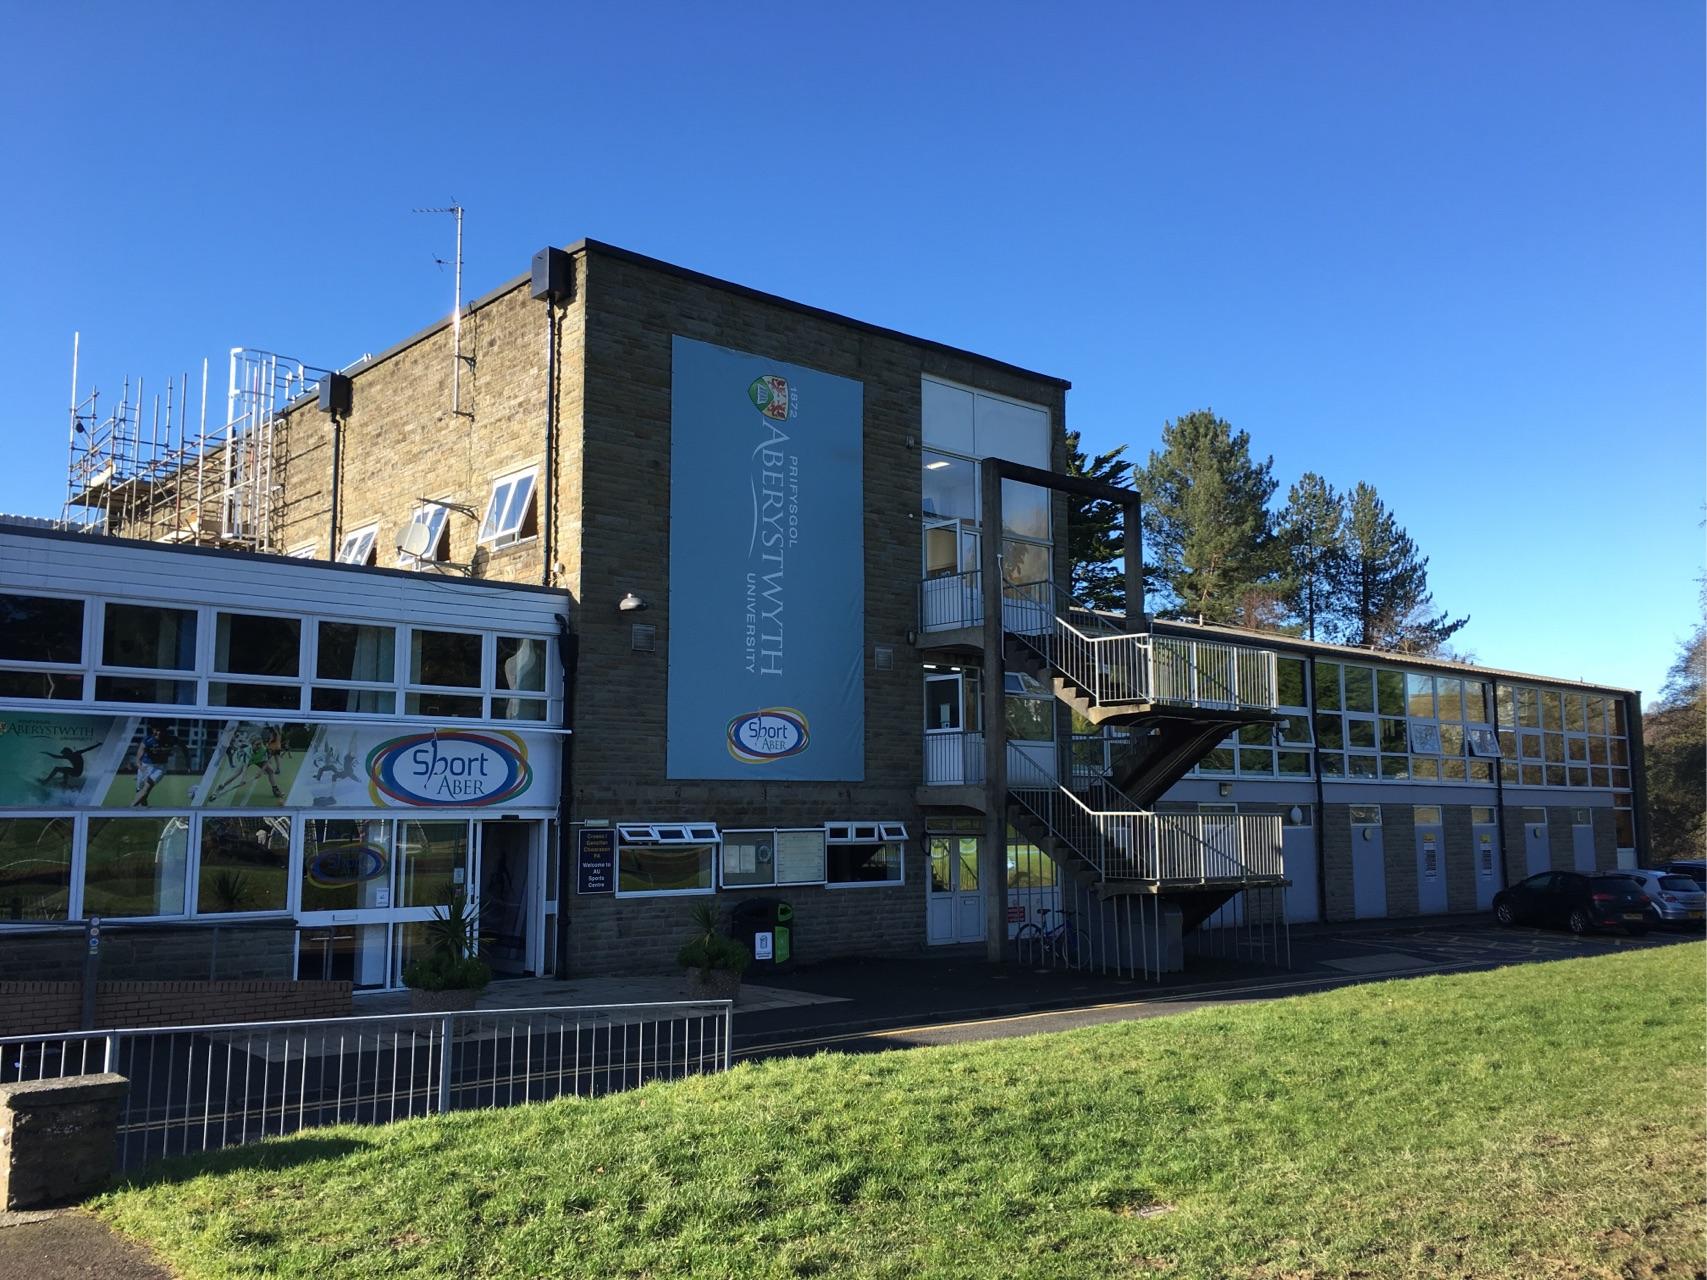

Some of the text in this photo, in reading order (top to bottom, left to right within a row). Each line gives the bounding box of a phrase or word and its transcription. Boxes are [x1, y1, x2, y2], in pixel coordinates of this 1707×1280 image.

[789, 386, 799, 419] 1872
[788, 455, 799, 548] PRIFYSGOL
[751, 416, 790, 677] ABERYSTWYTH
[746, 572, 756, 674] UNIVERSITY
[7, 722, 94, 737] ABERYSTWYTH
[748, 717, 788, 743] Sport
[761, 737, 787, 752] ABER
[412, 741, 489, 783] Sport
[436, 775, 486, 800] ABER
